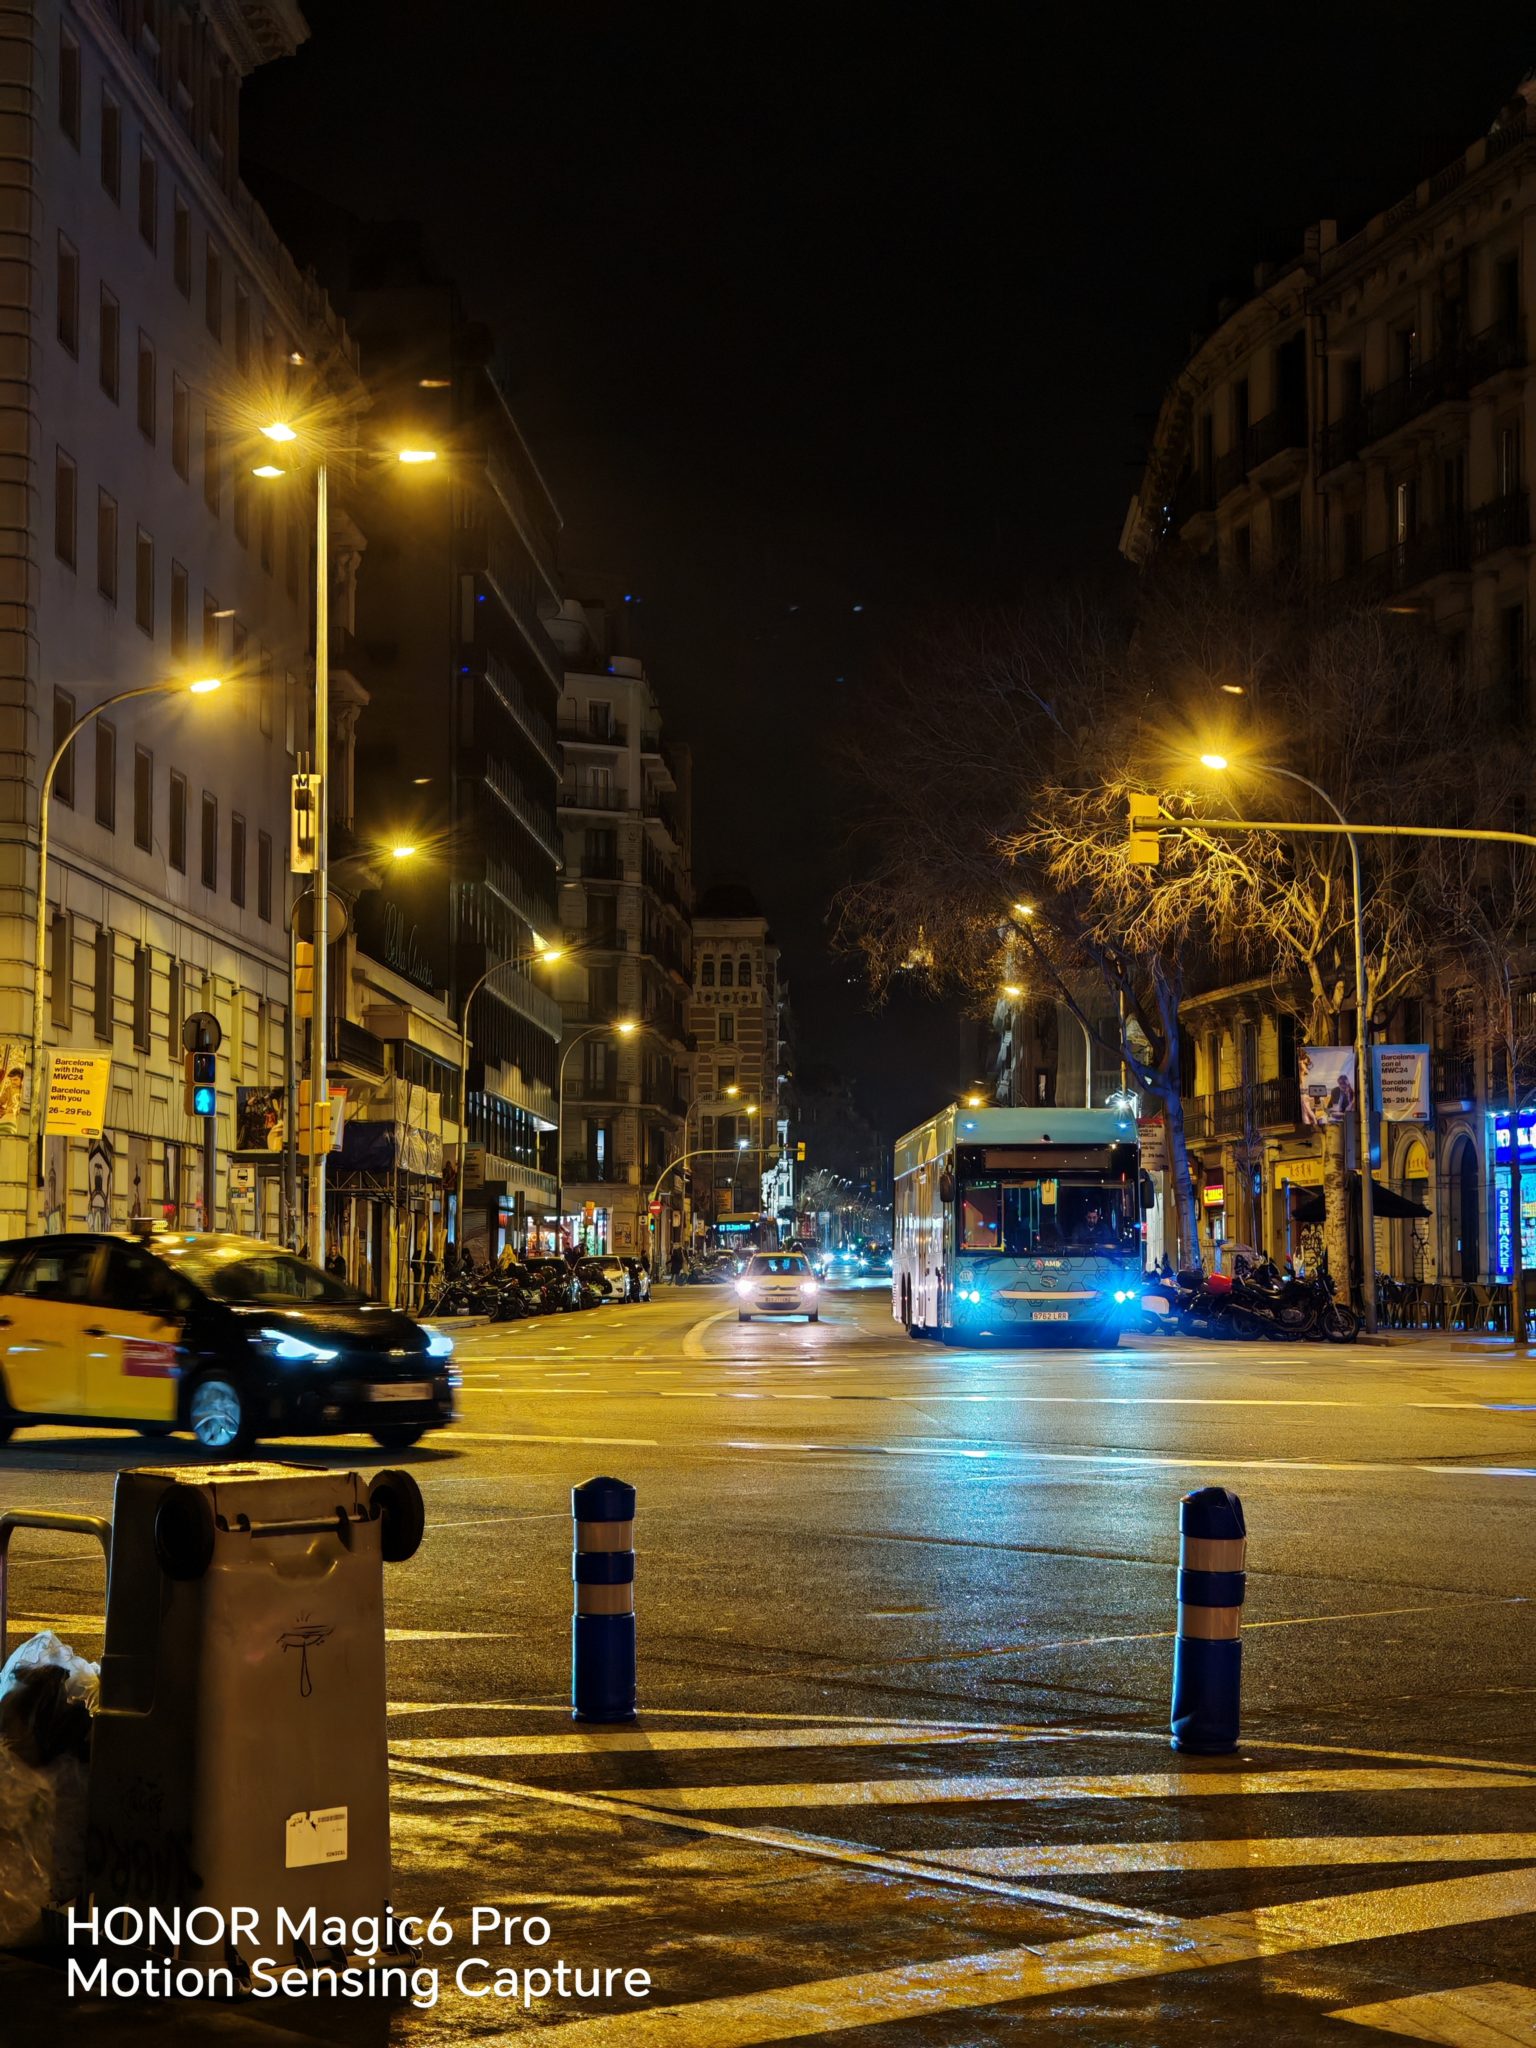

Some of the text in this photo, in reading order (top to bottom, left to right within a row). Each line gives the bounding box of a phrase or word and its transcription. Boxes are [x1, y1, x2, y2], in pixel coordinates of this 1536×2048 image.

[55, 1058, 94, 1067] Barcelona
[53, 1073, 84, 1081] MWC24
[51, 1086, 90, 1095] Barcelona
[1382, 1085, 1408, 1093] contigo
[76, 1108, 92, 1116] Feb
[1498, 1190, 1510, 1273] SUPERMARKET
